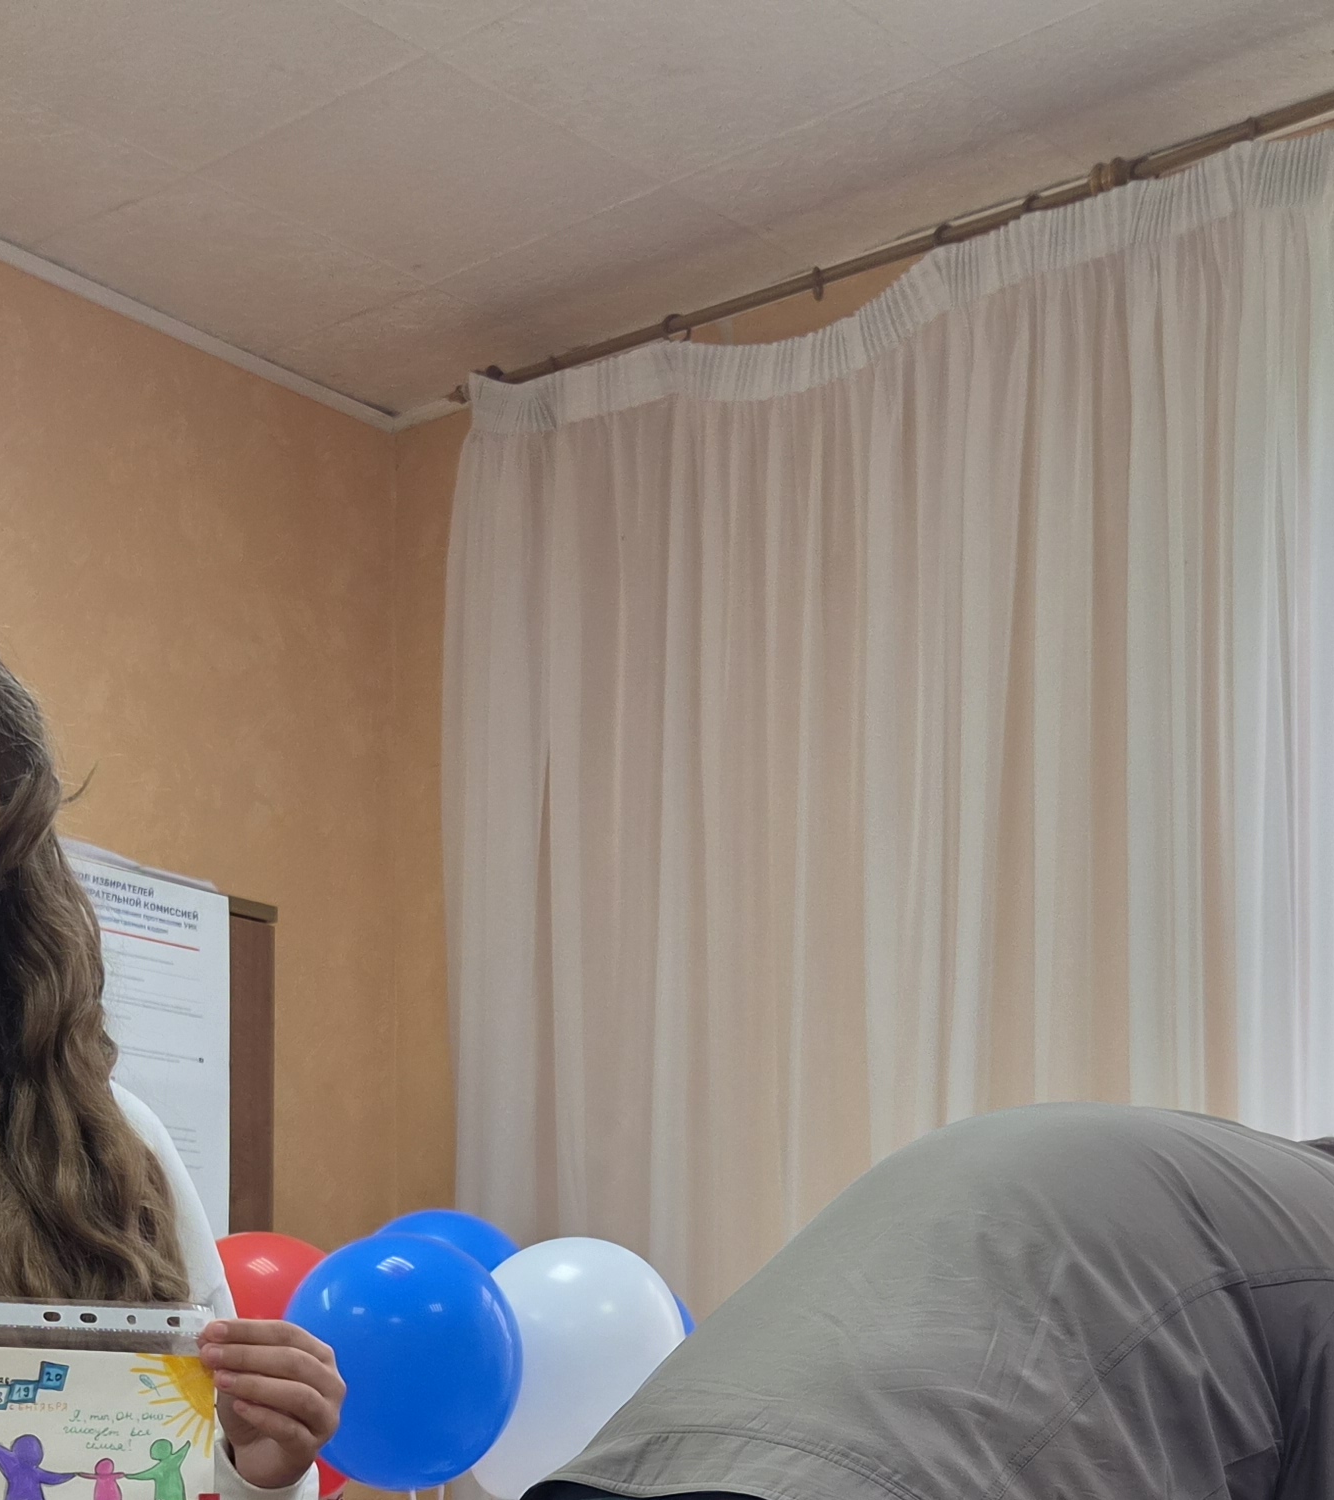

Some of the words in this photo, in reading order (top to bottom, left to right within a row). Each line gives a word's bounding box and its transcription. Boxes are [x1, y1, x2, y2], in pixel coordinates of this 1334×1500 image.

[92, 875, 155, 898] ИЗБИРАТЕЛЕЙ
[88, 888, 142, 908] РАТЕЛЬНОЙ
[143, 901, 199, 921] КОМИССИЕЙ
[16, 1387, 30, 1398] 19
[45, 1372, 62, 1383] 20
